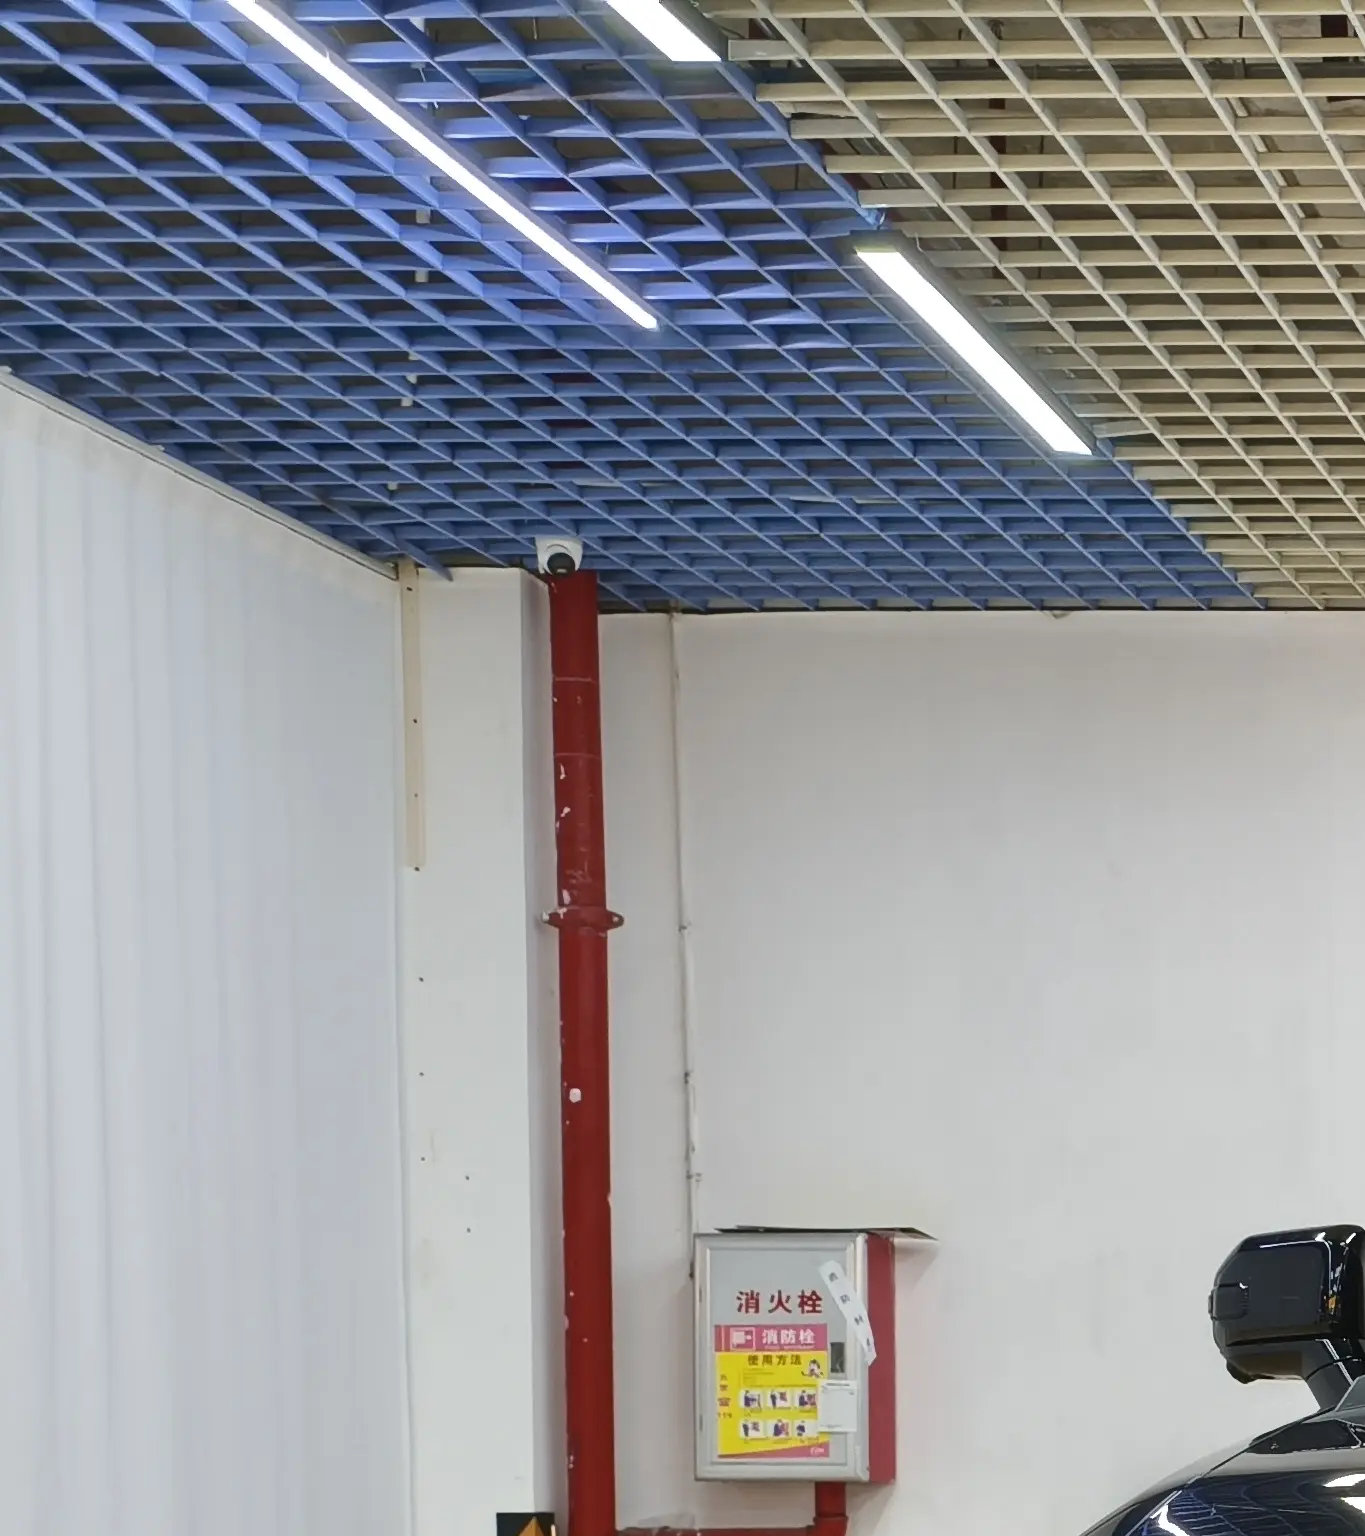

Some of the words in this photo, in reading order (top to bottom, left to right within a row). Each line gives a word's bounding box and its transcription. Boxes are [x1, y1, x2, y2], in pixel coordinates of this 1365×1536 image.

[736, 1289, 822, 1314] 消火栓
[762, 1329, 815, 1345] 消防栓
